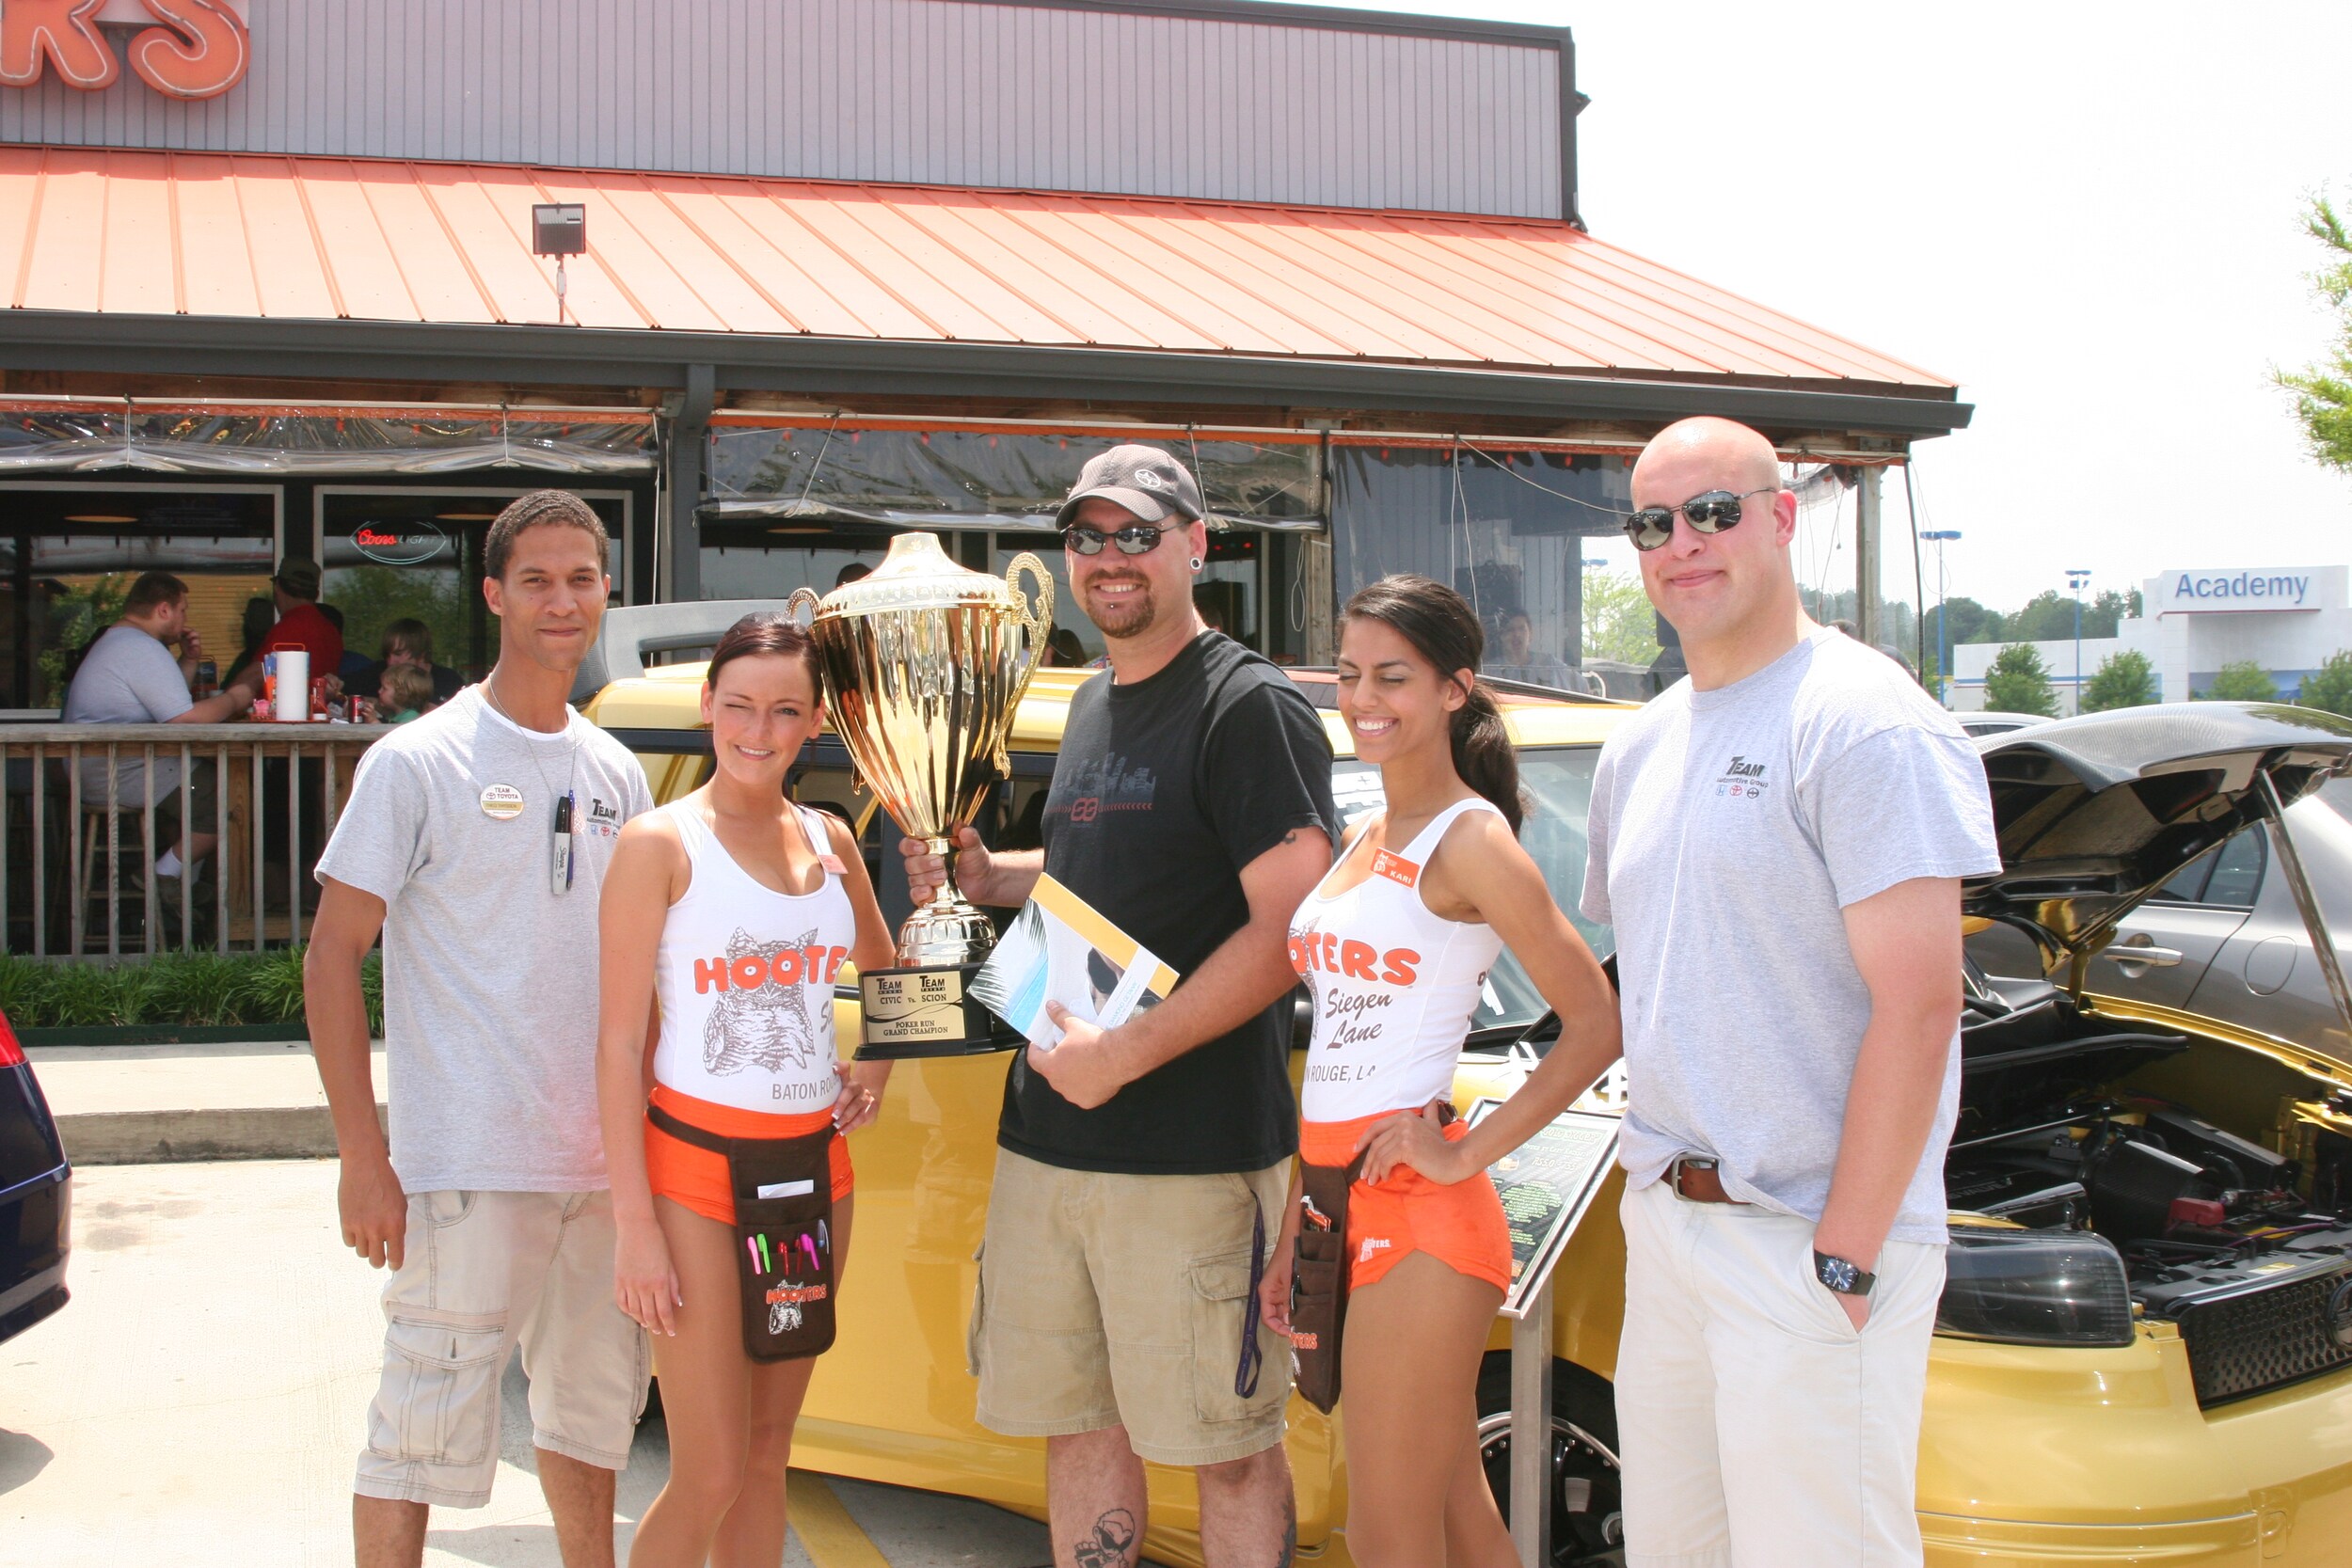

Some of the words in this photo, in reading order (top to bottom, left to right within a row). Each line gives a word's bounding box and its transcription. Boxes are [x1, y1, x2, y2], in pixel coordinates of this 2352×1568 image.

[358, 529, 396, 545] Coors
[2175, 572, 2309, 604] Academy
[1726, 755, 1765, 777] TEAM
[592, 798, 617, 820] TEAM
[1390, 870, 1412, 884] KARI
[876, 977, 902, 990] TEAM
[919, 975, 946, 988] TEAM
[880, 996, 901, 1005] CIVIC
[922, 994, 946, 1003] SCION
[1326, 988, 1392, 1021] Siegen
[882, 1028, 908, 1037] GRAND
[910, 1026, 948, 1035] CHAMPION
[1327, 1020, 1382, 1051] Lane
[771, 1082, 818, 1101] BATON
[766, 1284, 827, 1305] HOOTERS
